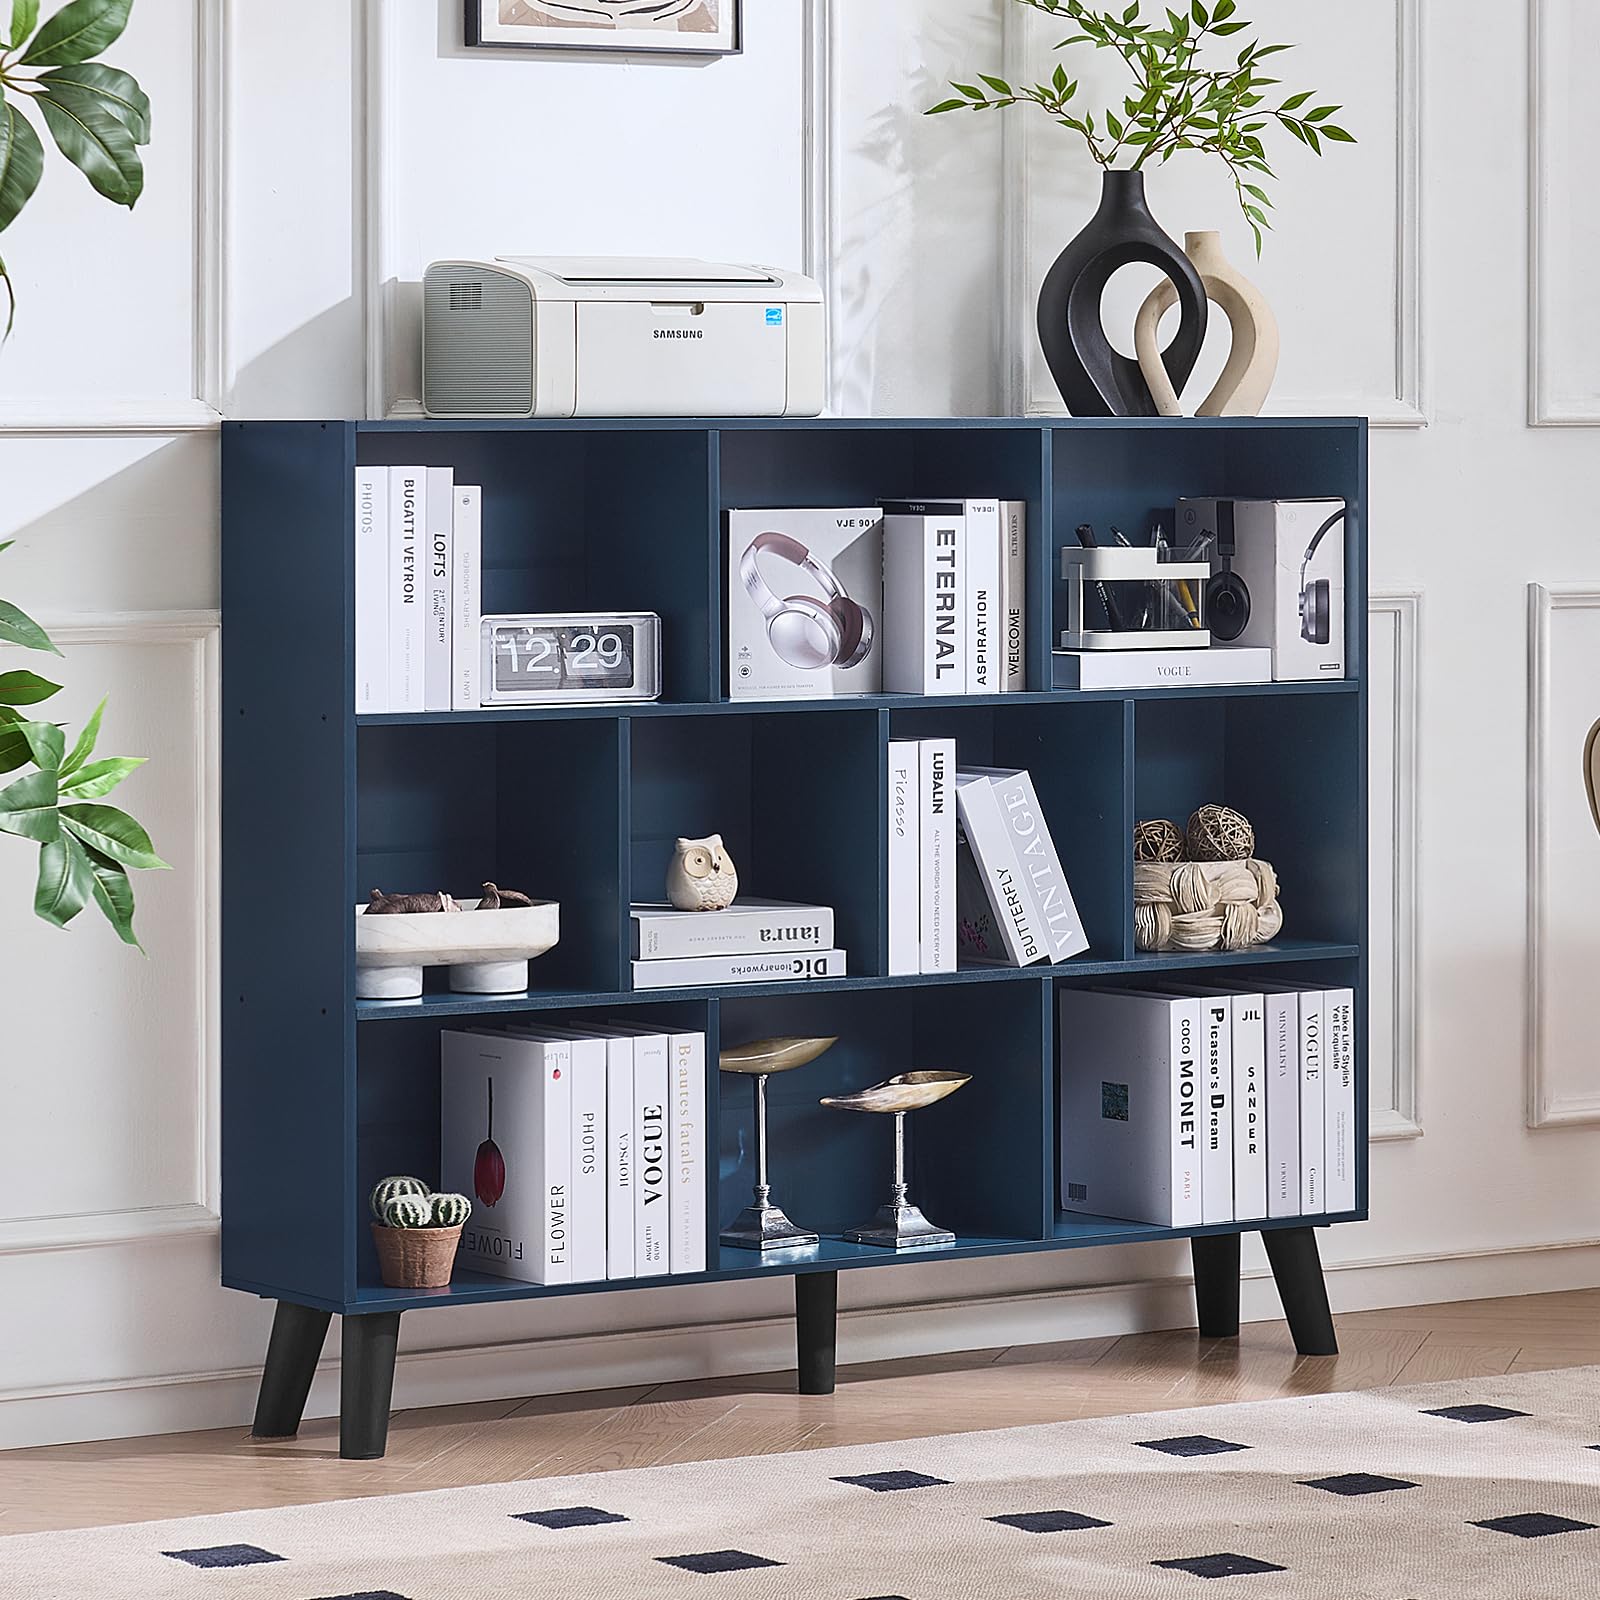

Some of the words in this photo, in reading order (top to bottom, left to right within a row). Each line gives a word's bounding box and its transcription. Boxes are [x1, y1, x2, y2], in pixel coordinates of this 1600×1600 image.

[653, 329, 703, 339] SAMSUNG
[361, 483, 373, 534] PHOTOS
[403, 479, 415, 540] BUGATTI
[836, 519, 856, 528] VJE
[858, 519, 876, 528] 901
[403, 546, 415, 604] VEYRON
[433, 533, 446, 577] LOFTS
[935, 529, 956, 680] ETERNAL
[977, 590, 987, 686] ASPIRATION
[1008, 608, 1020, 677] WELCOME
[1157, 665, 1192, 677] VOGUE
[932, 752, 944, 814] LUBALIN
[1003, 786, 1073, 952] VINTAGE
[759, 926, 820, 944] ianra
[996, 868, 1038, 958] BUTTERFLY
[1241, 1010, 1261, 1021] JIL
[1332, 1005, 1340, 1022] Yet
[1341, 1005, 1350, 1032] Make
[1341, 1034, 1350, 1052] Life
[1210, 1007, 1225, 1090] Picasso's
[1306, 1013, 1319, 1081] VOGUE
[1332, 1025, 1340, 1070] Exquisite
[1341, 1054, 1350, 1087] Stylish
[678, 1044, 692, 1117] Beautes
[1180, 1060, 1195, 1150] MONET
[1247, 1066, 1257, 1155] SANDER
[582, 1112, 595, 1174] PHOTOS
[1210, 1094, 1225, 1150] Dream
[643, 1104, 663, 1206] VOGUE
[680, 1122, 695, 1185] fatales
[551, 1184, 565, 1264] FLOWER
